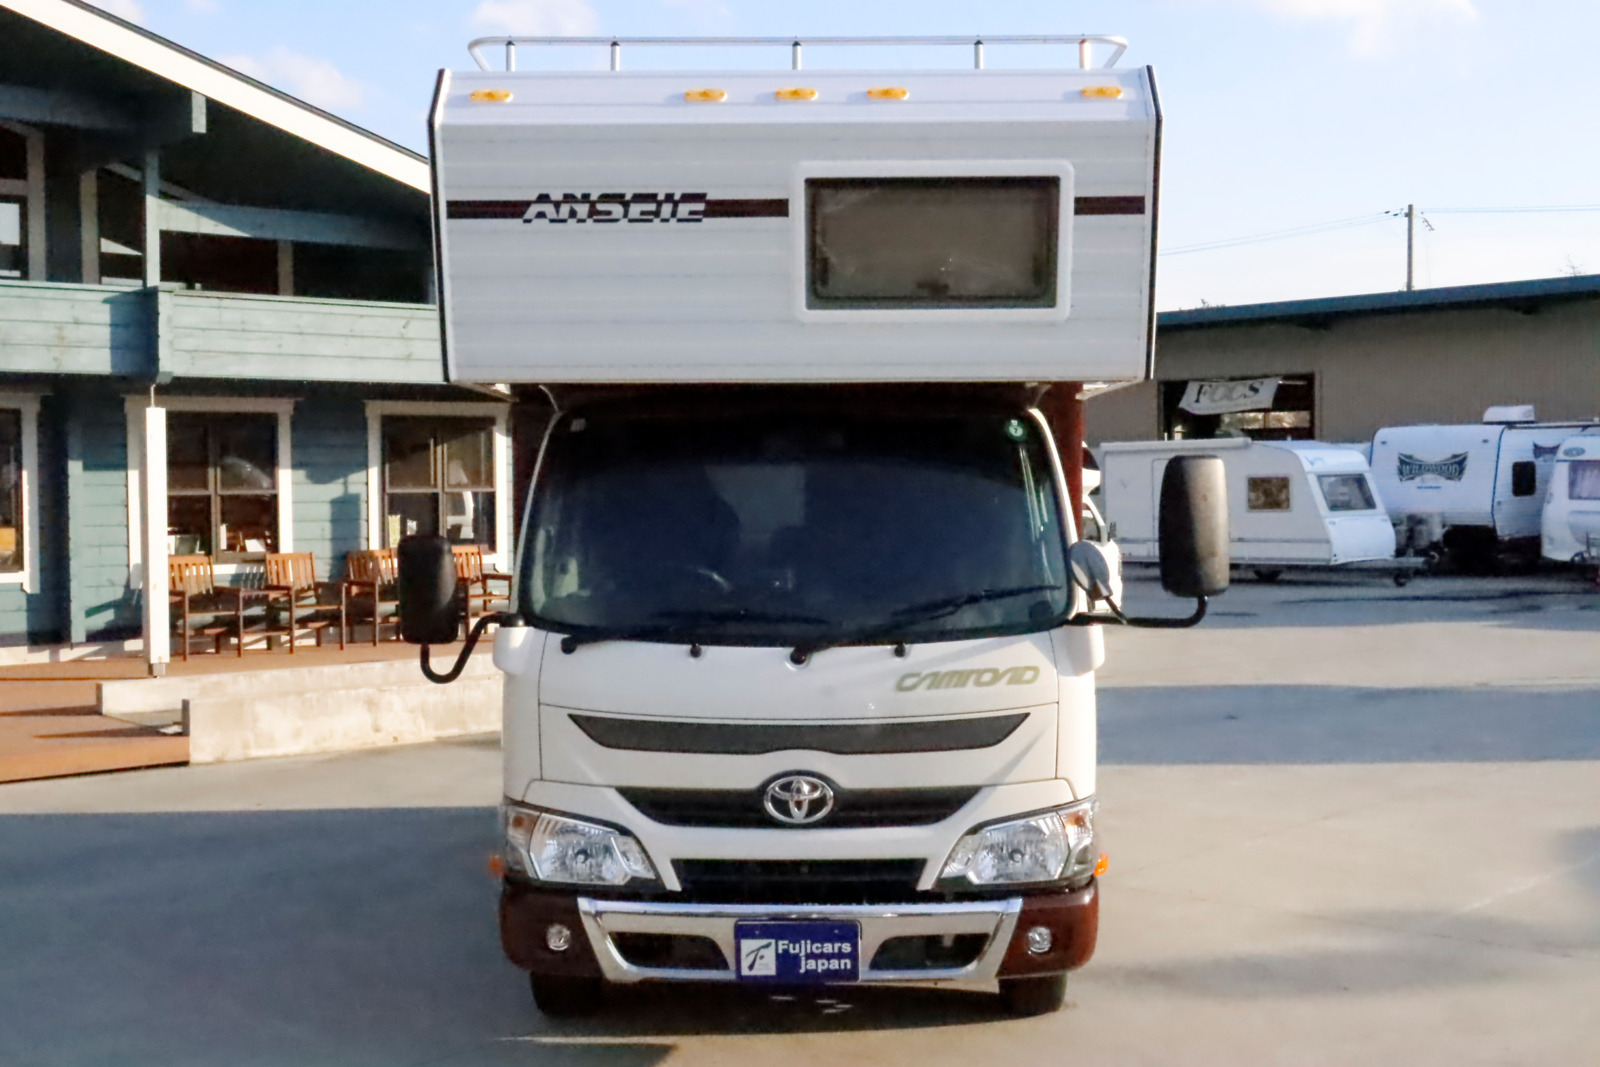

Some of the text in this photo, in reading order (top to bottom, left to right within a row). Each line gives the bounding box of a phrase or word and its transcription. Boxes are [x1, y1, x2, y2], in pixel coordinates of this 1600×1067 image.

[895, 665, 1041, 692] CAMROAD
[777, 940, 852, 957] Fujicars
[799, 956, 852, 974] japan
